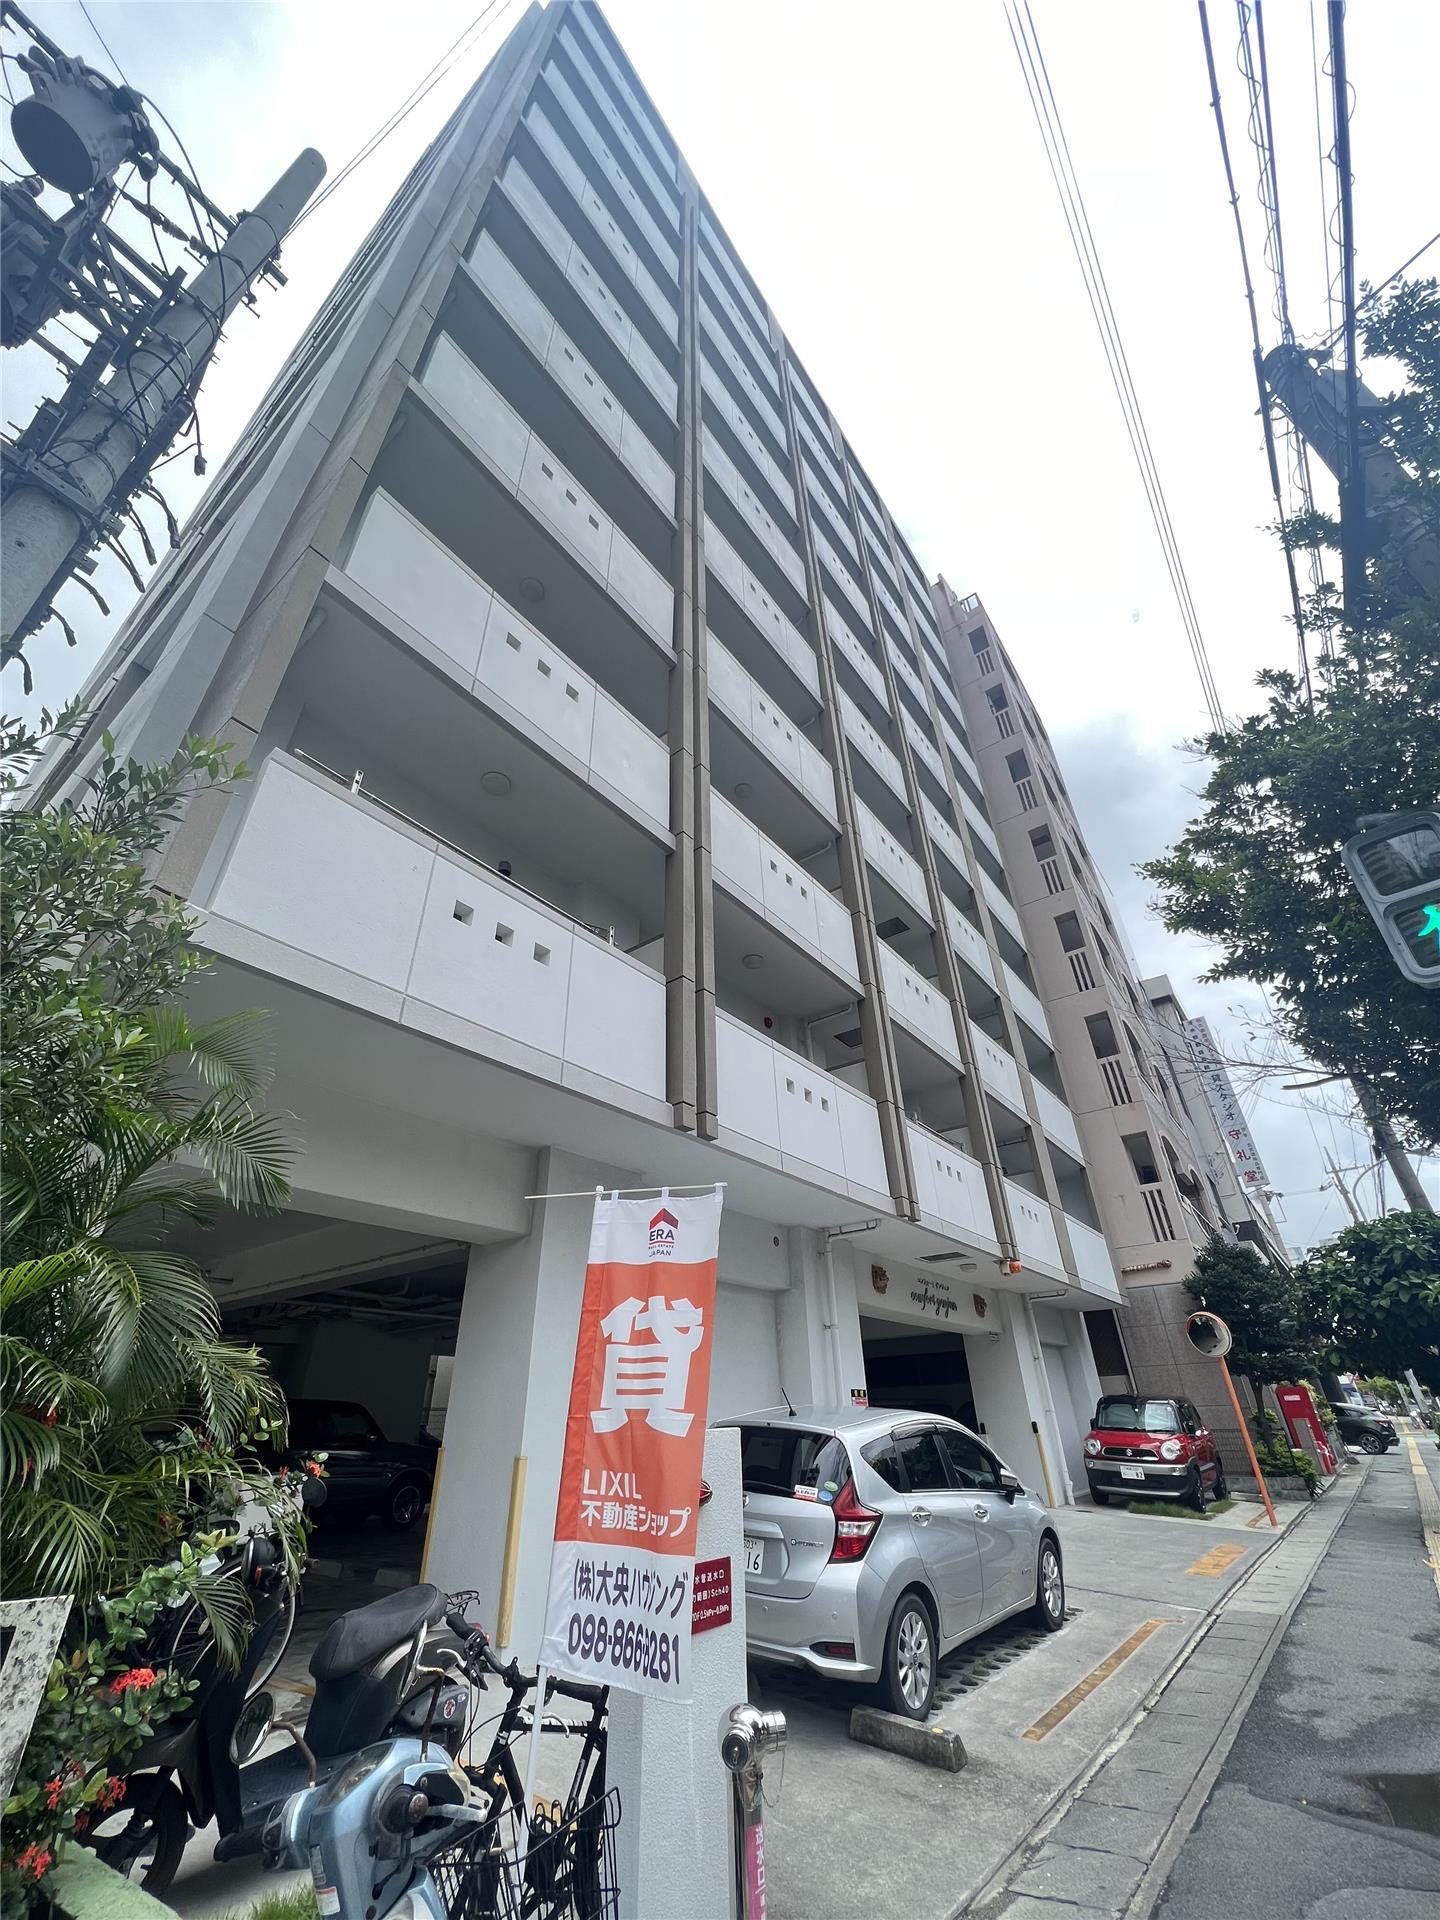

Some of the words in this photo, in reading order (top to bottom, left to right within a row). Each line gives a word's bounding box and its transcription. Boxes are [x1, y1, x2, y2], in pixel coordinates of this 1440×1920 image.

[1228, 1128, 1260, 1183] 守礼堂
[649, 1229, 675, 1242] ERA
[649, 1249, 672, 1258] JAPAN
[590, 1295, 705, 1438] 貸
[582, 1468, 642, 1500] LIXIL
[580, 1499, 692, 1538] 不動産ショップ
